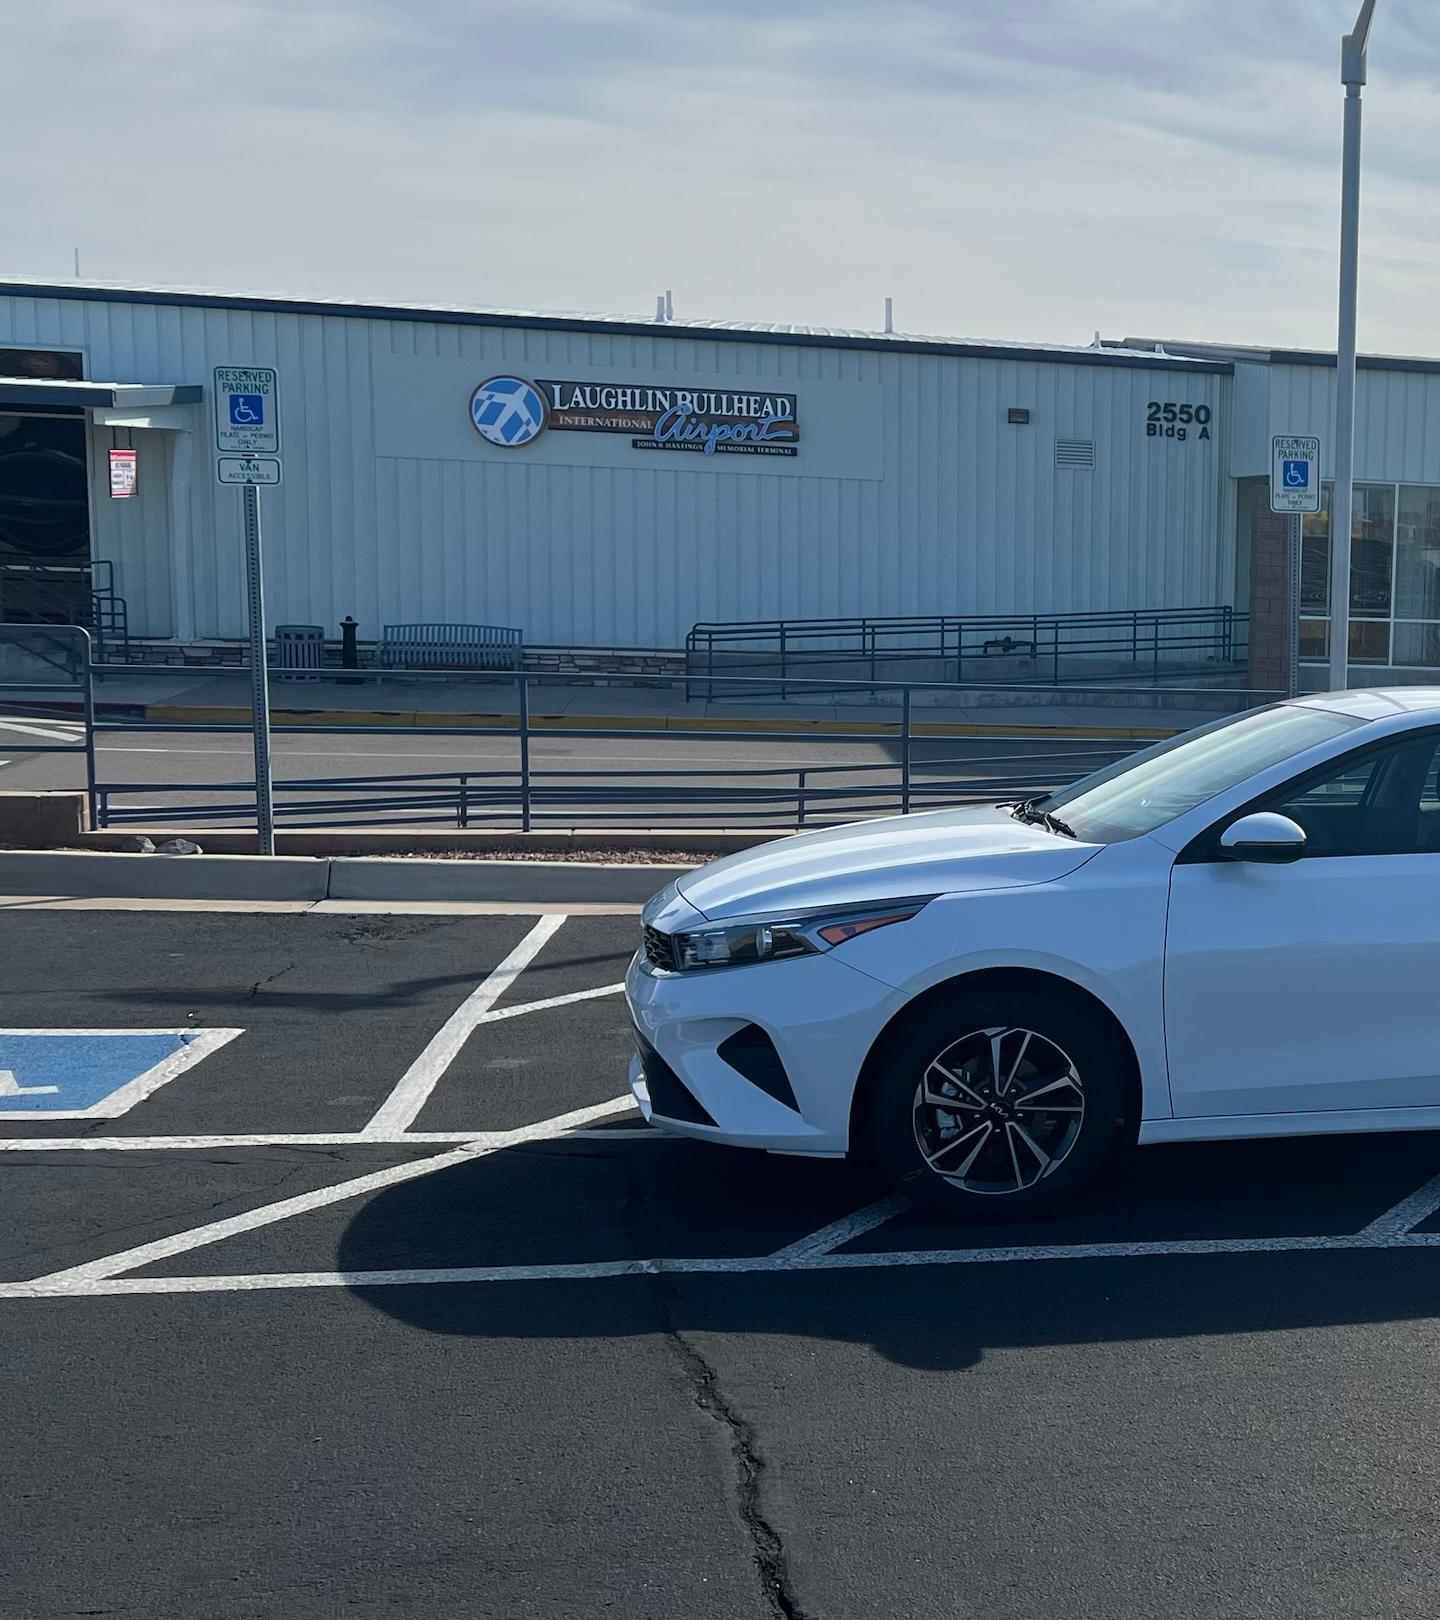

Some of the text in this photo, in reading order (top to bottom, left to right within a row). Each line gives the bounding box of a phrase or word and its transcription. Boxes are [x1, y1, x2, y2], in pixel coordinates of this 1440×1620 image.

[218, 370, 272, 383] RESERVED
[222, 382, 269, 394] PARKING
[552, 384, 791, 418] LAUGHLIN BULLHEAD
[1147, 401, 1211, 424] 2550
[559, 415, 653, 430] INTERNATIONAL
[653, 403, 794, 457] Airport
[1146, 423, 1210, 441] Bldg A
[636, 440, 657, 448] JOHN
[665, 441, 704, 450] HASTINGS
[717, 444, 755, 453] MEMORIAL
[757, 446, 792, 455] TERMINAL
[1275, 439, 1317, 450] RESERVED
[1278, 450, 1314, 460] PARKING
[239, 463, 260, 472] VAN
